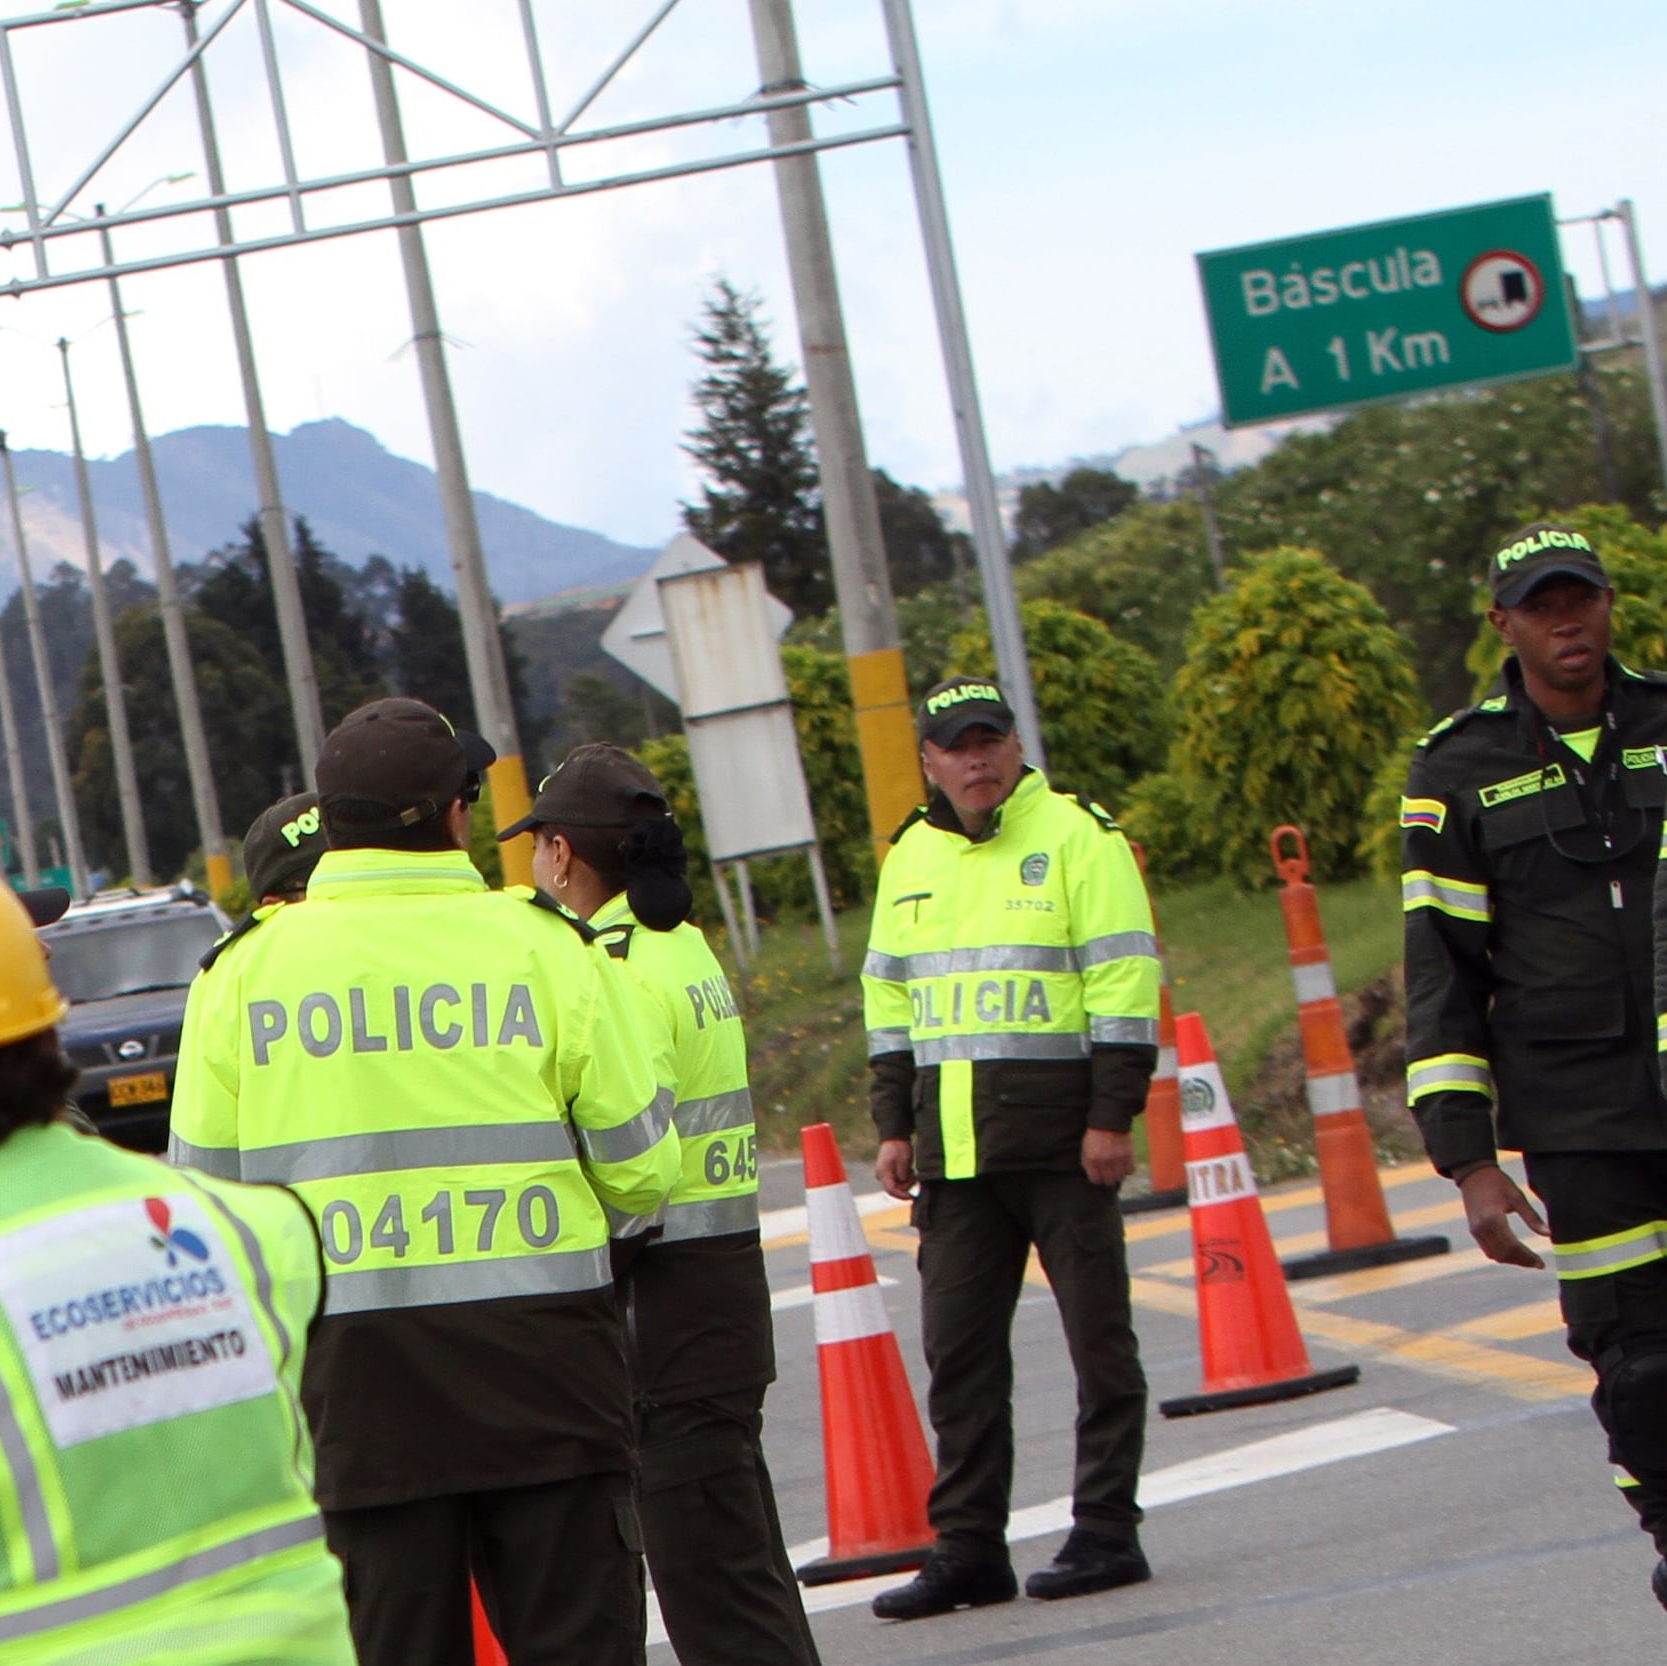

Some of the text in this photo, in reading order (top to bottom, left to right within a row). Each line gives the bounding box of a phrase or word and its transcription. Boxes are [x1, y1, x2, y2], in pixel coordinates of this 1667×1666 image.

[1241, 246, 1443, 317] Báscula
[1261, 328, 1451, 394] A 1 Km
[1496, 530, 1592, 571] POLICIA
[927, 684, 1001, 715] POLICIA
[247, 982, 544, 1067] POLICIA
[320, 1184, 561, 1265] 04170
[30, 1267, 226, 1341] ECOSERVICIOS
[54, 1329, 247, 1400] MANTENIMIENTO
